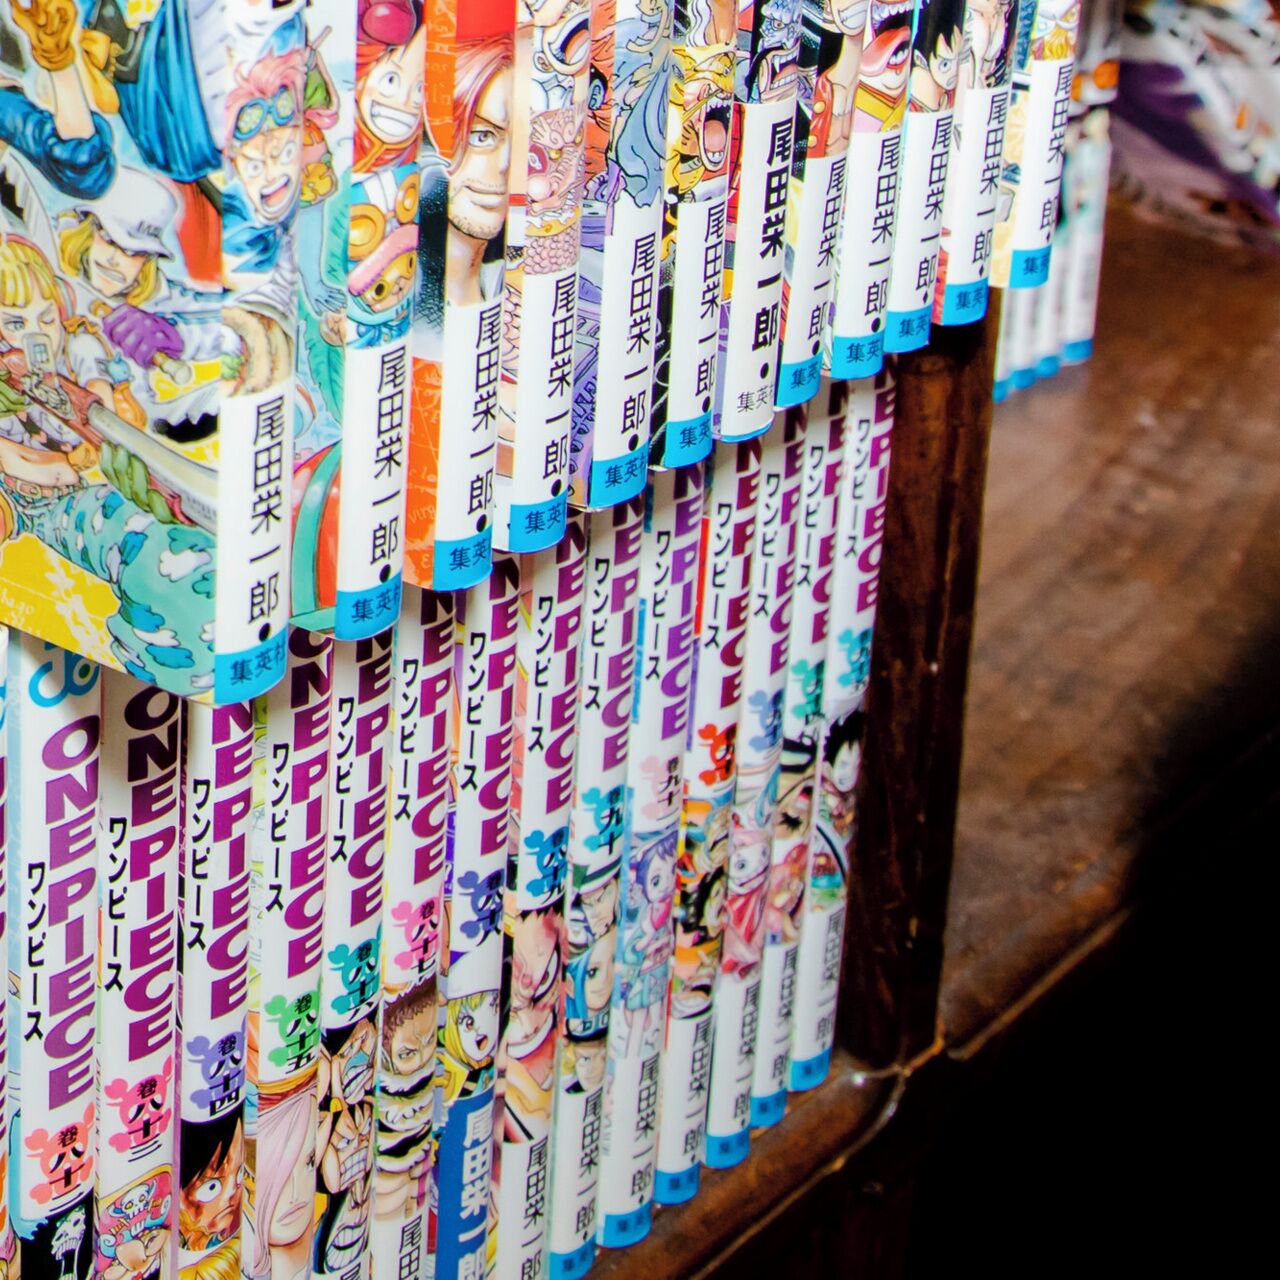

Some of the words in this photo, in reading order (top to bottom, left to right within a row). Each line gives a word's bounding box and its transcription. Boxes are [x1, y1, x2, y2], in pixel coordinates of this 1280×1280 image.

[752, 116, 794, 366] 尾田栄一郎
[865, 134, 900, 317] 尾田栄一郎
[916, 114, 953, 292] 尾田栄一郎
[971, 92, 1008, 262] 尾田栄一郎
[543, 271, 579, 482] 尾田栄一郎
[620, 231, 658, 442] 尾田栄一郎
[696, 204, 726, 401] 尾田栄一郎
[370, 345, 407, 566] 尾田栄一郎
[466, 302, 503, 517] 尾田栄一郎
[844, 418, 871, 558] ワンピース
[248, 396, 286, 625] 尾田栄一郎
[645, 530, 671, 680] ワンピース
[460, 632, 487, 791] ワンピース
[528, 596, 554, 752] ワンピース
[585, 558, 610, 711] ワンピース
[601, 575, 639, 772] PIECE
[662, 545, 698, 741] PIECE
[42, 715, 100, 872] ONE
[123, 686, 180, 827] ONE
[348, 704, 388, 927] PIECE
[395, 659, 420, 821] ワンピース
[23, 862, 48, 1042] ワンピース
[104, 818, 128, 992] ワンピース
[124, 825, 177, 1062] PIECE
[187, 779, 212, 950] ワンピース
[207, 798, 252, 1020] PIECE
[284, 753, 330, 978] PIECE
[43, 867, 97, 1111] PIECE
